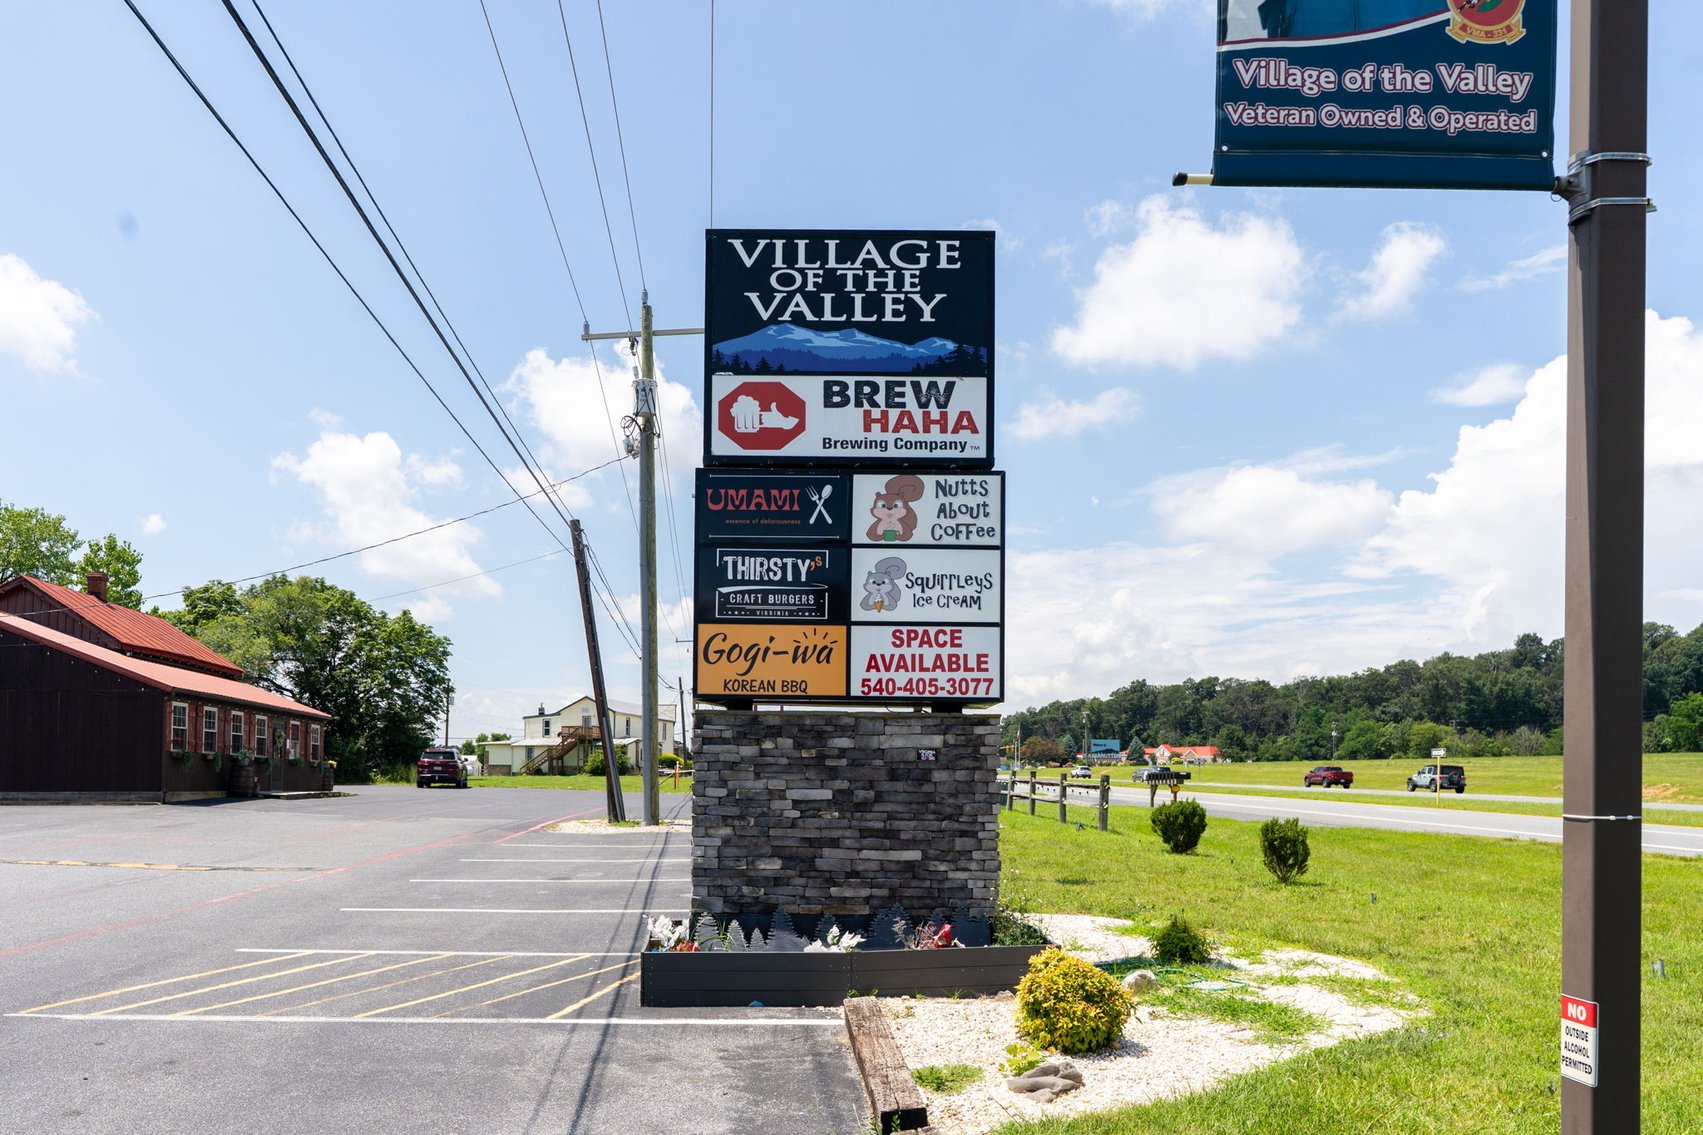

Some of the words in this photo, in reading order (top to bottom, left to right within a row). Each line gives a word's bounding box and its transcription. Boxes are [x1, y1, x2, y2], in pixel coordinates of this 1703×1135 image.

[1233, 59, 1336, 96] Village
[1342, 63, 1377, 92] of
[1380, 64, 1432, 92] the
[1436, 63, 1533, 102] Valley
[1225, 102, 1315, 125] Veteran
[1320, 103, 1402, 128] Owned
[1406, 108, 1427, 129] &
[1429, 106, 1537, 135] Operated
[728, 239, 961, 269] VILLAGE
[769, 269, 824, 291] OF
[836, 270, 921, 292] THE
[744, 292, 947, 322] VALLEY
[823, 380, 956, 409] BREW
[863, 409, 979, 434] HAHA
[822, 437, 888, 451] Brewing
[893, 438, 968, 452] Company
[935, 479, 989, 499] Nutts
[706, 489, 800, 511] UMAMI
[937, 501, 990, 519] About
[730, 594, 762, 604] CRAFT
[768, 595, 814, 604] BURGERS
[912, 593, 933, 607] Ice
[891, 629, 962, 648] SPACE
[865, 653, 989, 673] AVAILABLE
[723, 679, 776, 692] KOREAN
[781, 680, 808, 694] BBQ
[860, 677, 994, 696] 540-405-3077
[1567, 1002, 1587, 1021] NO
[1565, 1026, 1588, 1042] OUTSIDE
[1564, 1041, 1590, 1058] ALCOHOL
[1562, 1056, 1592, 1074] PERMITTED
